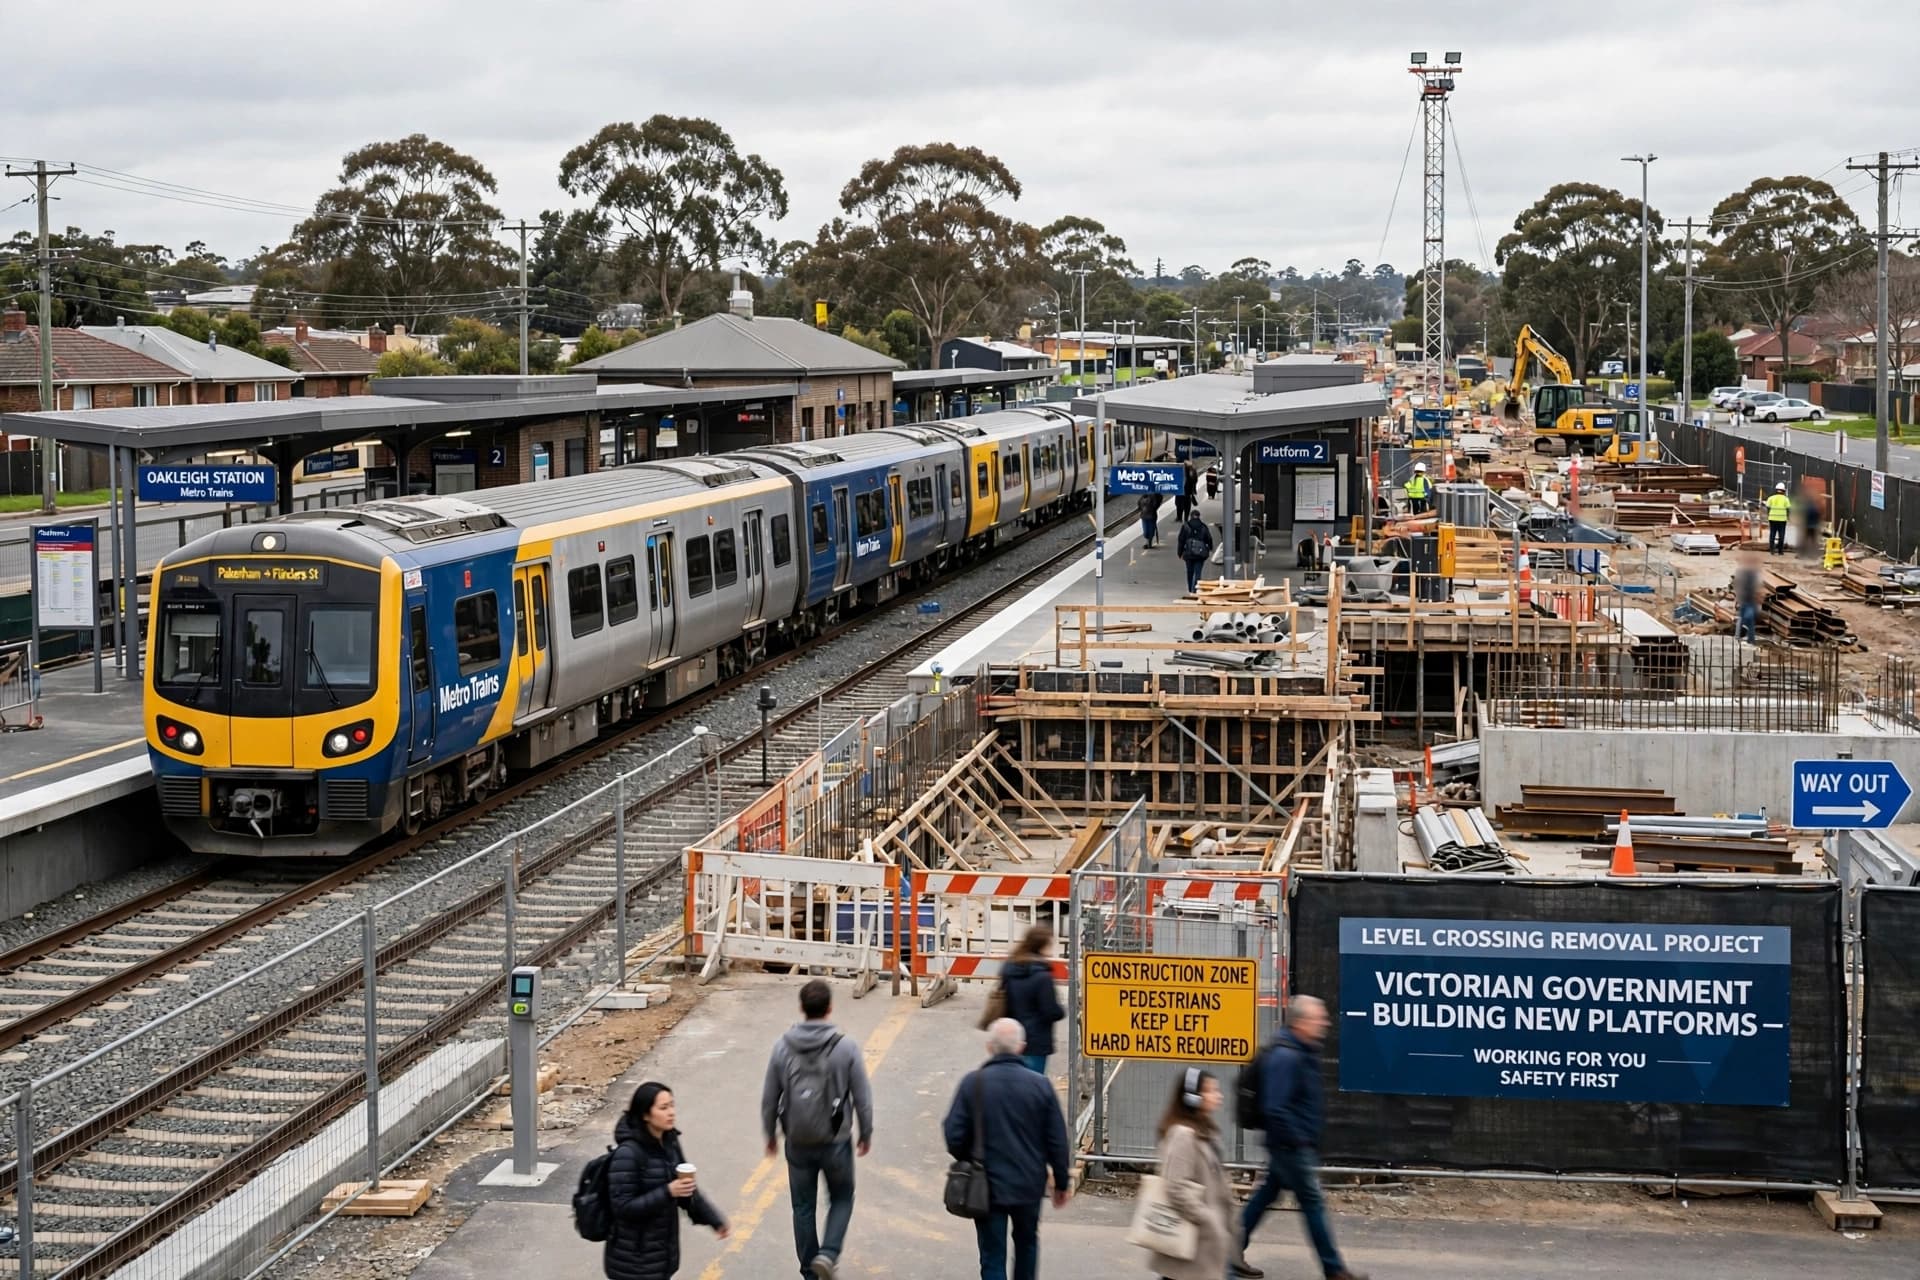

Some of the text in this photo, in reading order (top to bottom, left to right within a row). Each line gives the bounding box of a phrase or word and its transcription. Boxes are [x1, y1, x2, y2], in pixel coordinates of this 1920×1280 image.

[491, 449, 502, 464] 2
[1262, 444, 1324, 459] Platform 2
[147, 471, 265, 484] OAKLEIGH STATION
[1117, 469, 1145, 481] Metro
[180, 487, 234, 498] Metro Trains
[217, 566, 261, 580] Pakenham
[308, 568, 319, 580] St
[439, 673, 499, 713] Metro Trains
[1801, 773, 1890, 793] WAY OUT
[1361, 927, 1763, 954] LEVEL CROSSING REMOVAL PROJECT
[1091, 961, 1249, 984] CONSTRUCTION ZONE
[1375, 971, 1753, 1005] VICTORIAN GOVERNMENT
[1119, 989, 1221, 1010] PEDESTRIANS
[1131, 1012, 1209, 1032] KEEP LEFT
[1373, 1002, 1758, 1037] BUILDING NEW PLATFORMS
[1090, 1033, 1249, 1057] HARD HATS REQUIRED
[1473, 1048, 1647, 1069] WORKING FOR YOU
[1500, 1070, 1620, 1088] SAFETY FIRST
